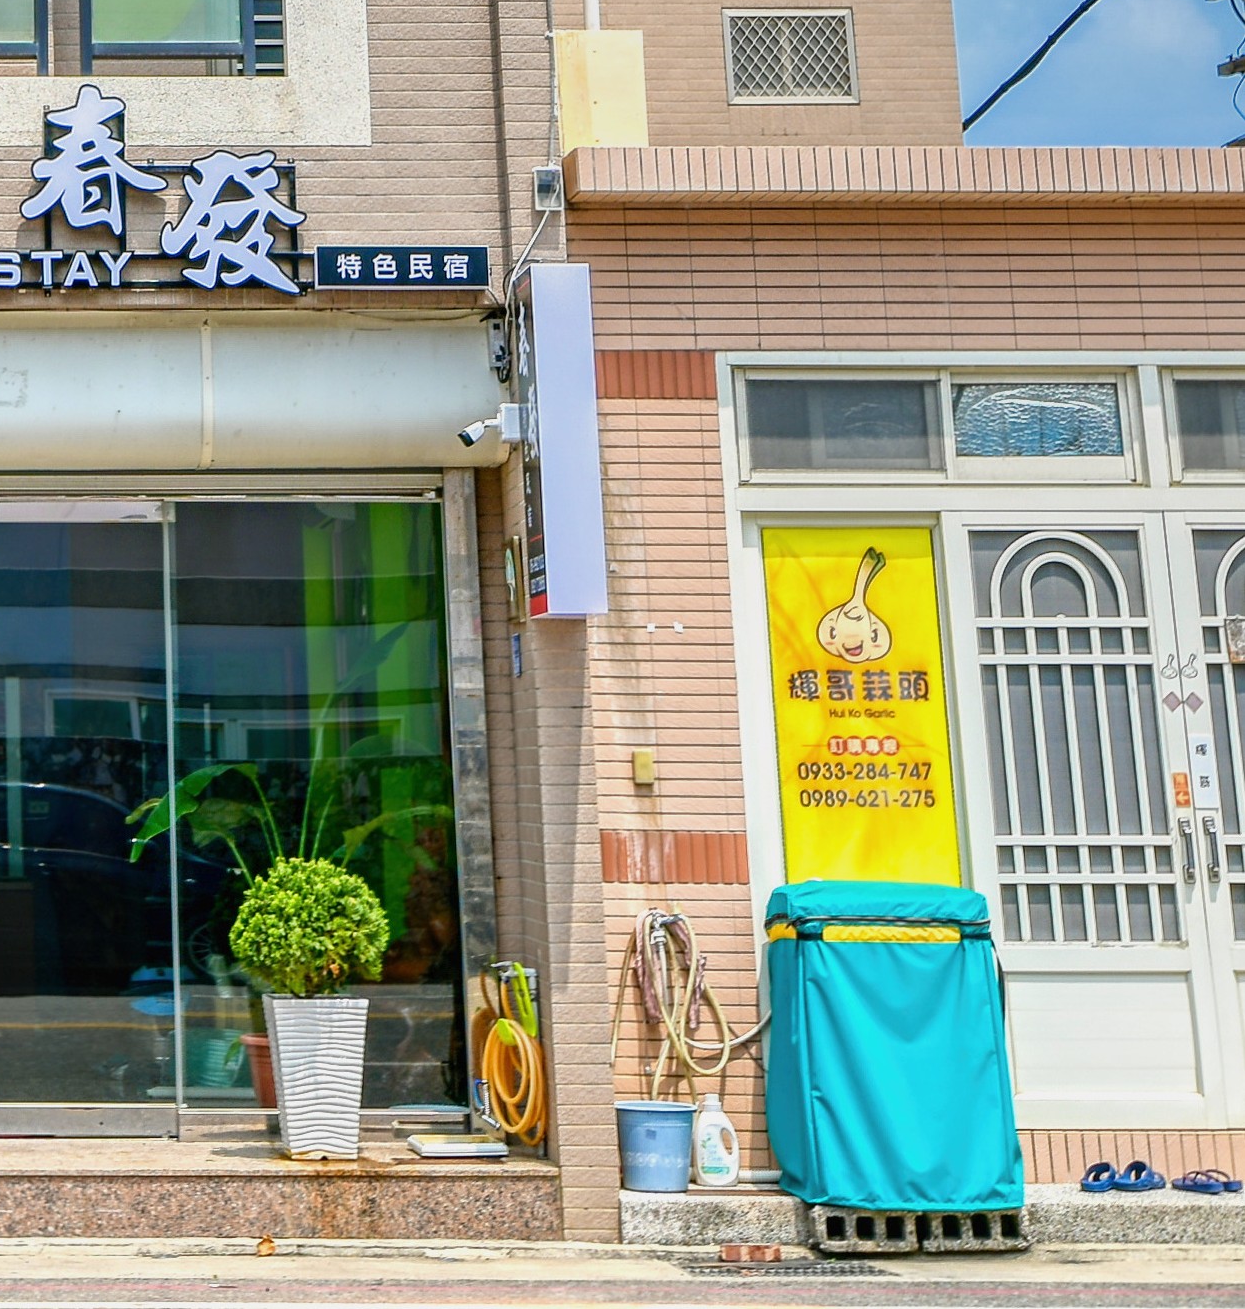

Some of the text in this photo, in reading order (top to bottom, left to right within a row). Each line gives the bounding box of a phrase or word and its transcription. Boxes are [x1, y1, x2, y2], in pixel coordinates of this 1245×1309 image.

[20, 84, 307, 296] 春發
[336, 253, 469, 280] 特色民宿
[788, 669, 930, 702] 輝哥蒜頭
[829, 708, 896, 719] Hui Ko Garlic
[797, 762, 932, 782] 0933-284-747
[799, 789, 936, 808] 0989-621-275
